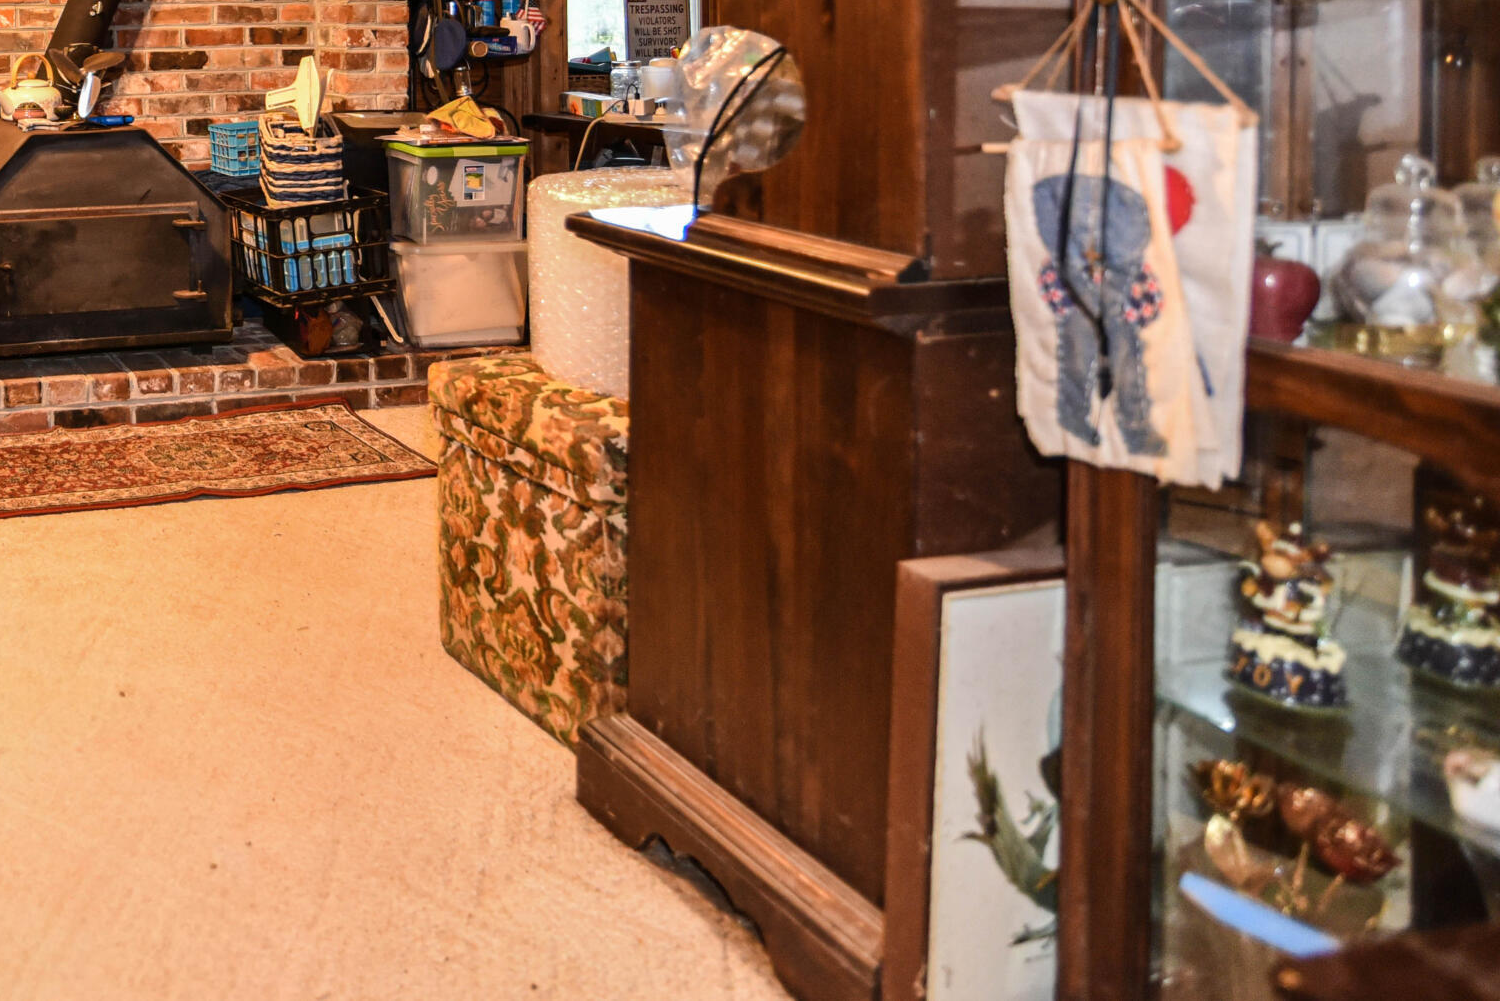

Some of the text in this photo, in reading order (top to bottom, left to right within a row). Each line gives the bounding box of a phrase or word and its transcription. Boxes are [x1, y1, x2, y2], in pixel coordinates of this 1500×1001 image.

[629, 4, 684, 14] TRESPASSING
[638, 16, 676, 25] VIOLATORS
[634, 26, 682, 36] WILL BE SHOT
[638, 37, 678, 47] SURVIVORS
[635, 48, 652, 58] WILL
[653, 48, 662, 57] BE
[1231, 655, 1304, 696] JOY
